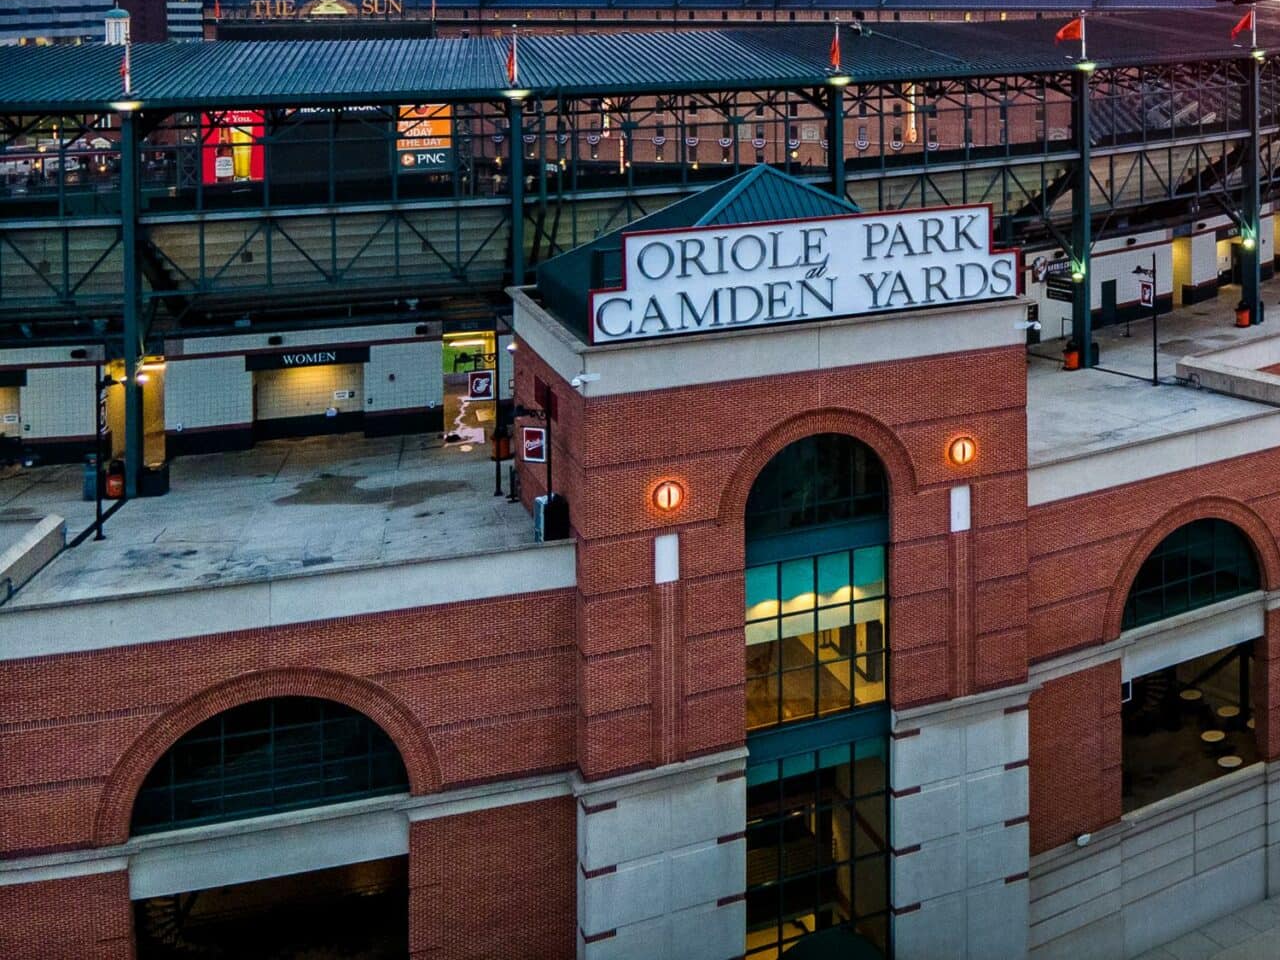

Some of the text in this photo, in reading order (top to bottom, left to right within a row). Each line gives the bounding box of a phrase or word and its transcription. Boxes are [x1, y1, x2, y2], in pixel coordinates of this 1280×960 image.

[251, 0, 296, 16] THE
[403, 127, 433, 137] ODAY
[423, 138, 442, 146] DAY
[416, 152, 447, 165] PNC
[636, 213, 984, 281] ORIOLE PARK
[805, 262, 830, 280] at
[596, 258, 1013, 338] CAMDEN YARDS
[282, 351, 337, 365] WOMEN
